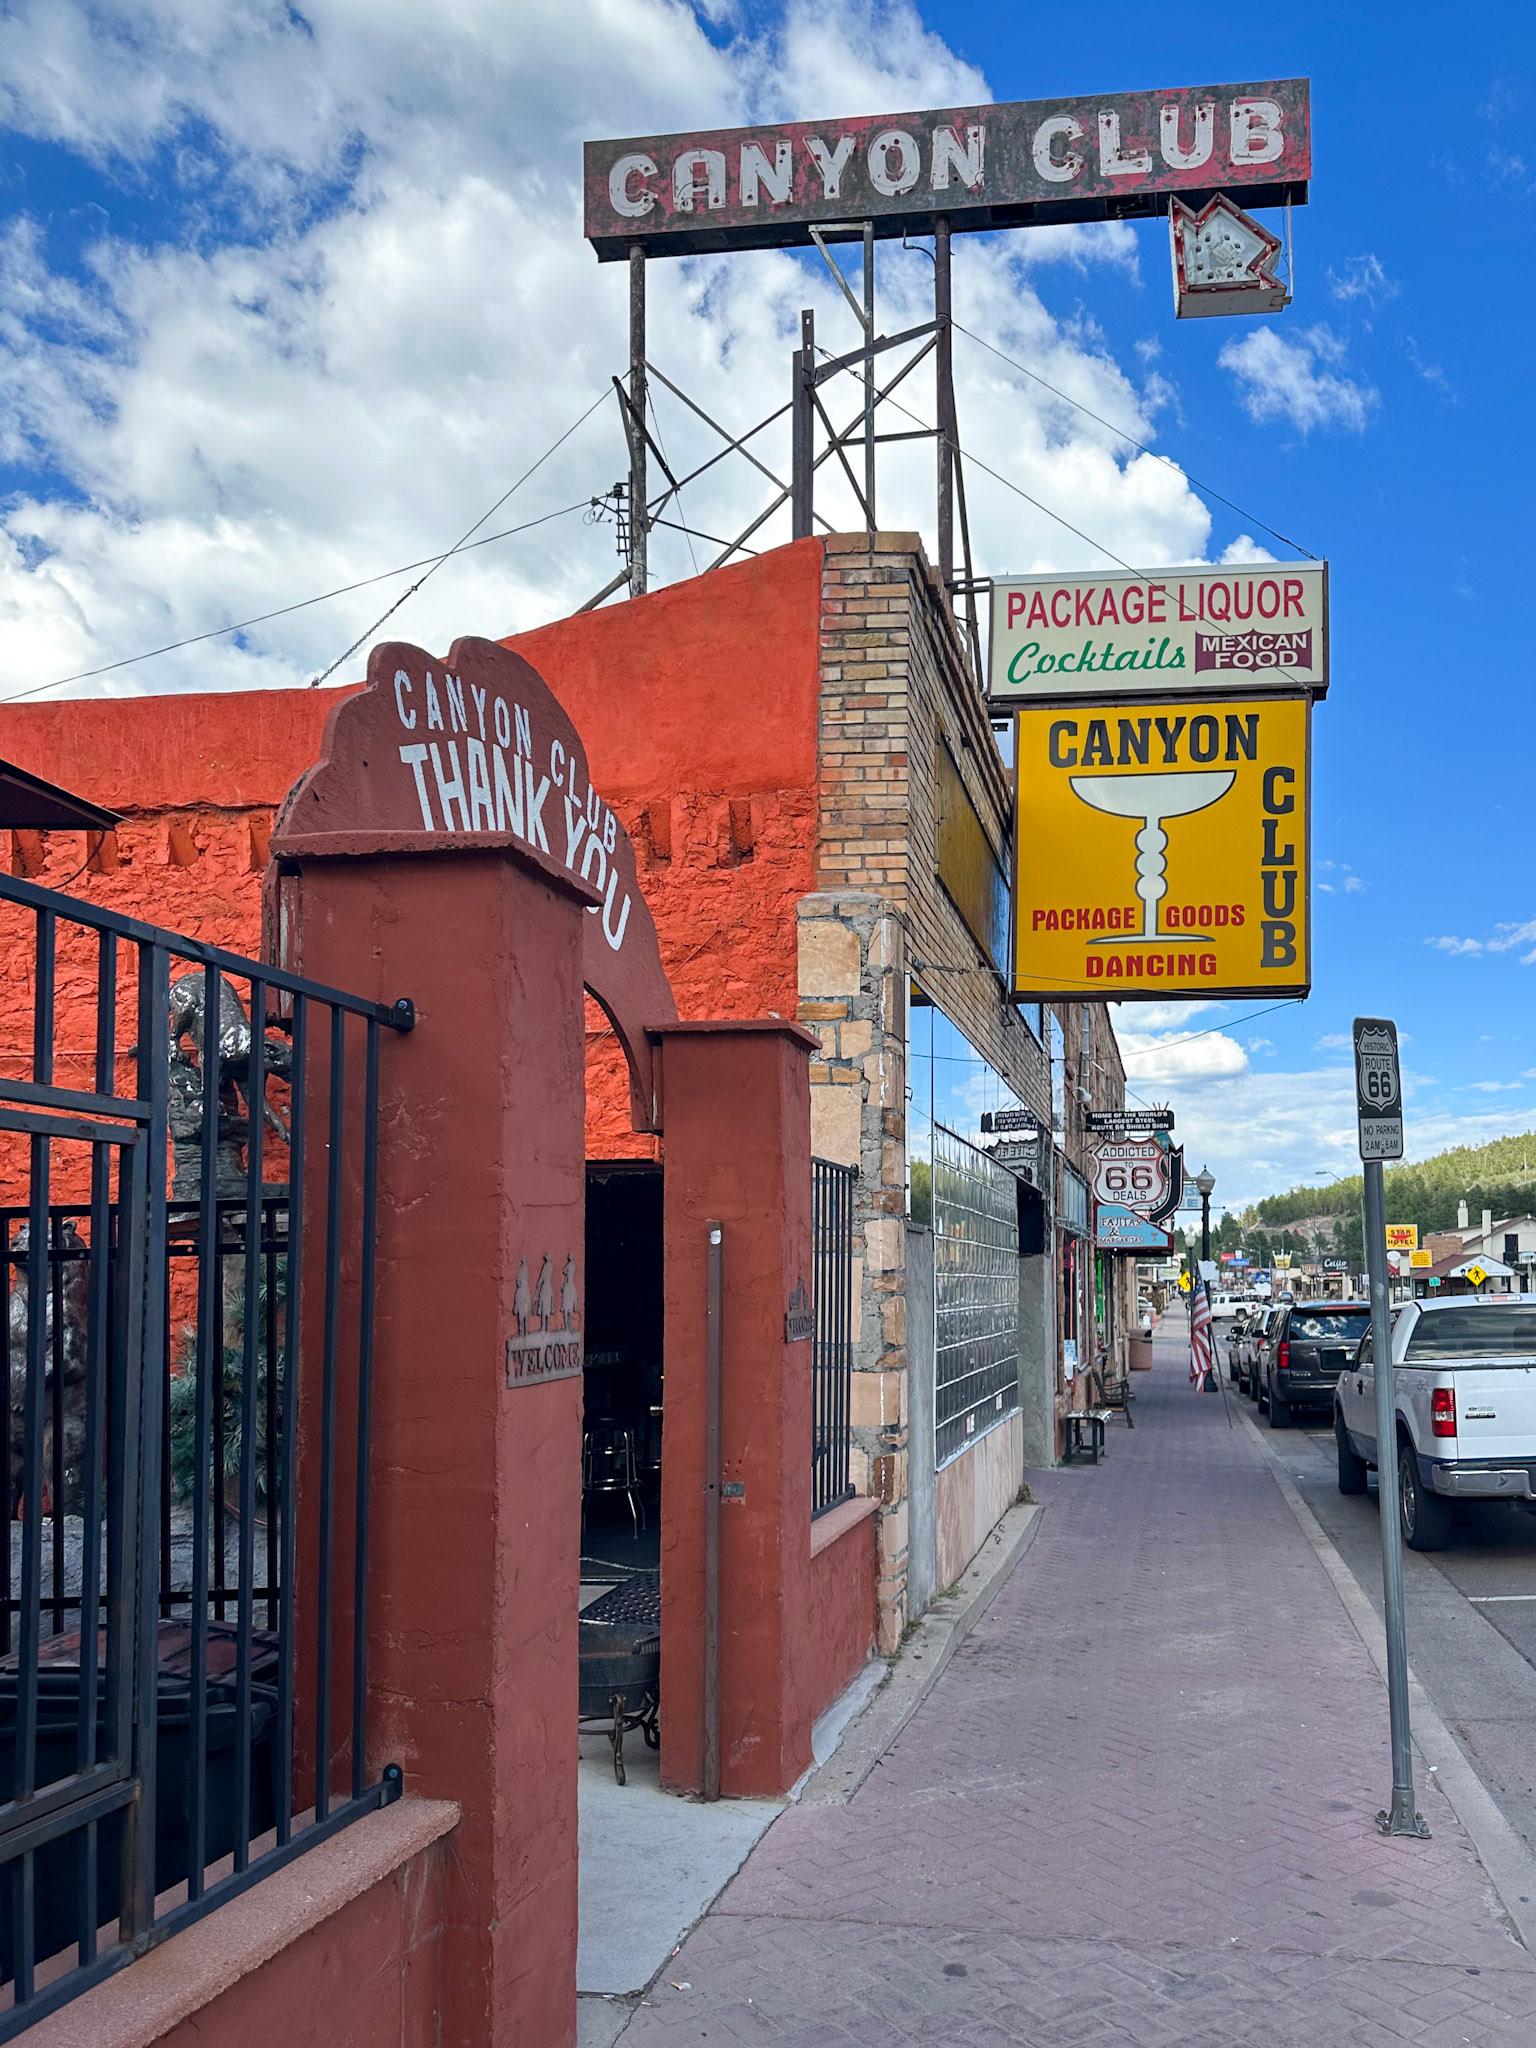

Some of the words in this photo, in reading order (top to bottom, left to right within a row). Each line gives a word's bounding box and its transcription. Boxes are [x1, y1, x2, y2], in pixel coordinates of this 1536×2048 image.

[609, 125, 986, 217] CANYON
[1033, 98, 1285, 183] CLUB
[1008, 584, 1167, 629] PACKAGE
[1179, 579, 1305, 622] LIQUOR
[1202, 632, 1307, 652] MEXICAN
[1007, 636, 1186, 684] Cocktails
[1215, 650, 1299, 669] FOOD
[1048, 714, 1260, 768] CANYON
[393, 669, 532, 760] CANYON
[551, 739, 617, 855] CLUB
[399, 737, 551, 855] THANK
[564, 794, 632, 952] YOU
[1260, 766, 1298, 969] CLUB
[1032, 907, 1135, 931] PACKAGE
[1166, 905, 1245, 928] GOODS
[1086, 953, 1217, 978] DANCING
[1364, 1041, 1390, 1052] HISTORIC
[1365, 1058, 1391, 1070] ROUTE
[1368, 1071, 1391, 1098] 66
[1363, 1125, 1374, 1136] NO
[1103, 1146, 1156, 1157] ADDICTED
[1106, 1166, 1153, 1190] 66
[1113, 1191, 1147, 1200] DEALS
[1101, 1217, 1142, 1227] FAJITAS
[1109, 1227, 1120, 1237] &
[511, 1342, 580, 1378] WELCOME
